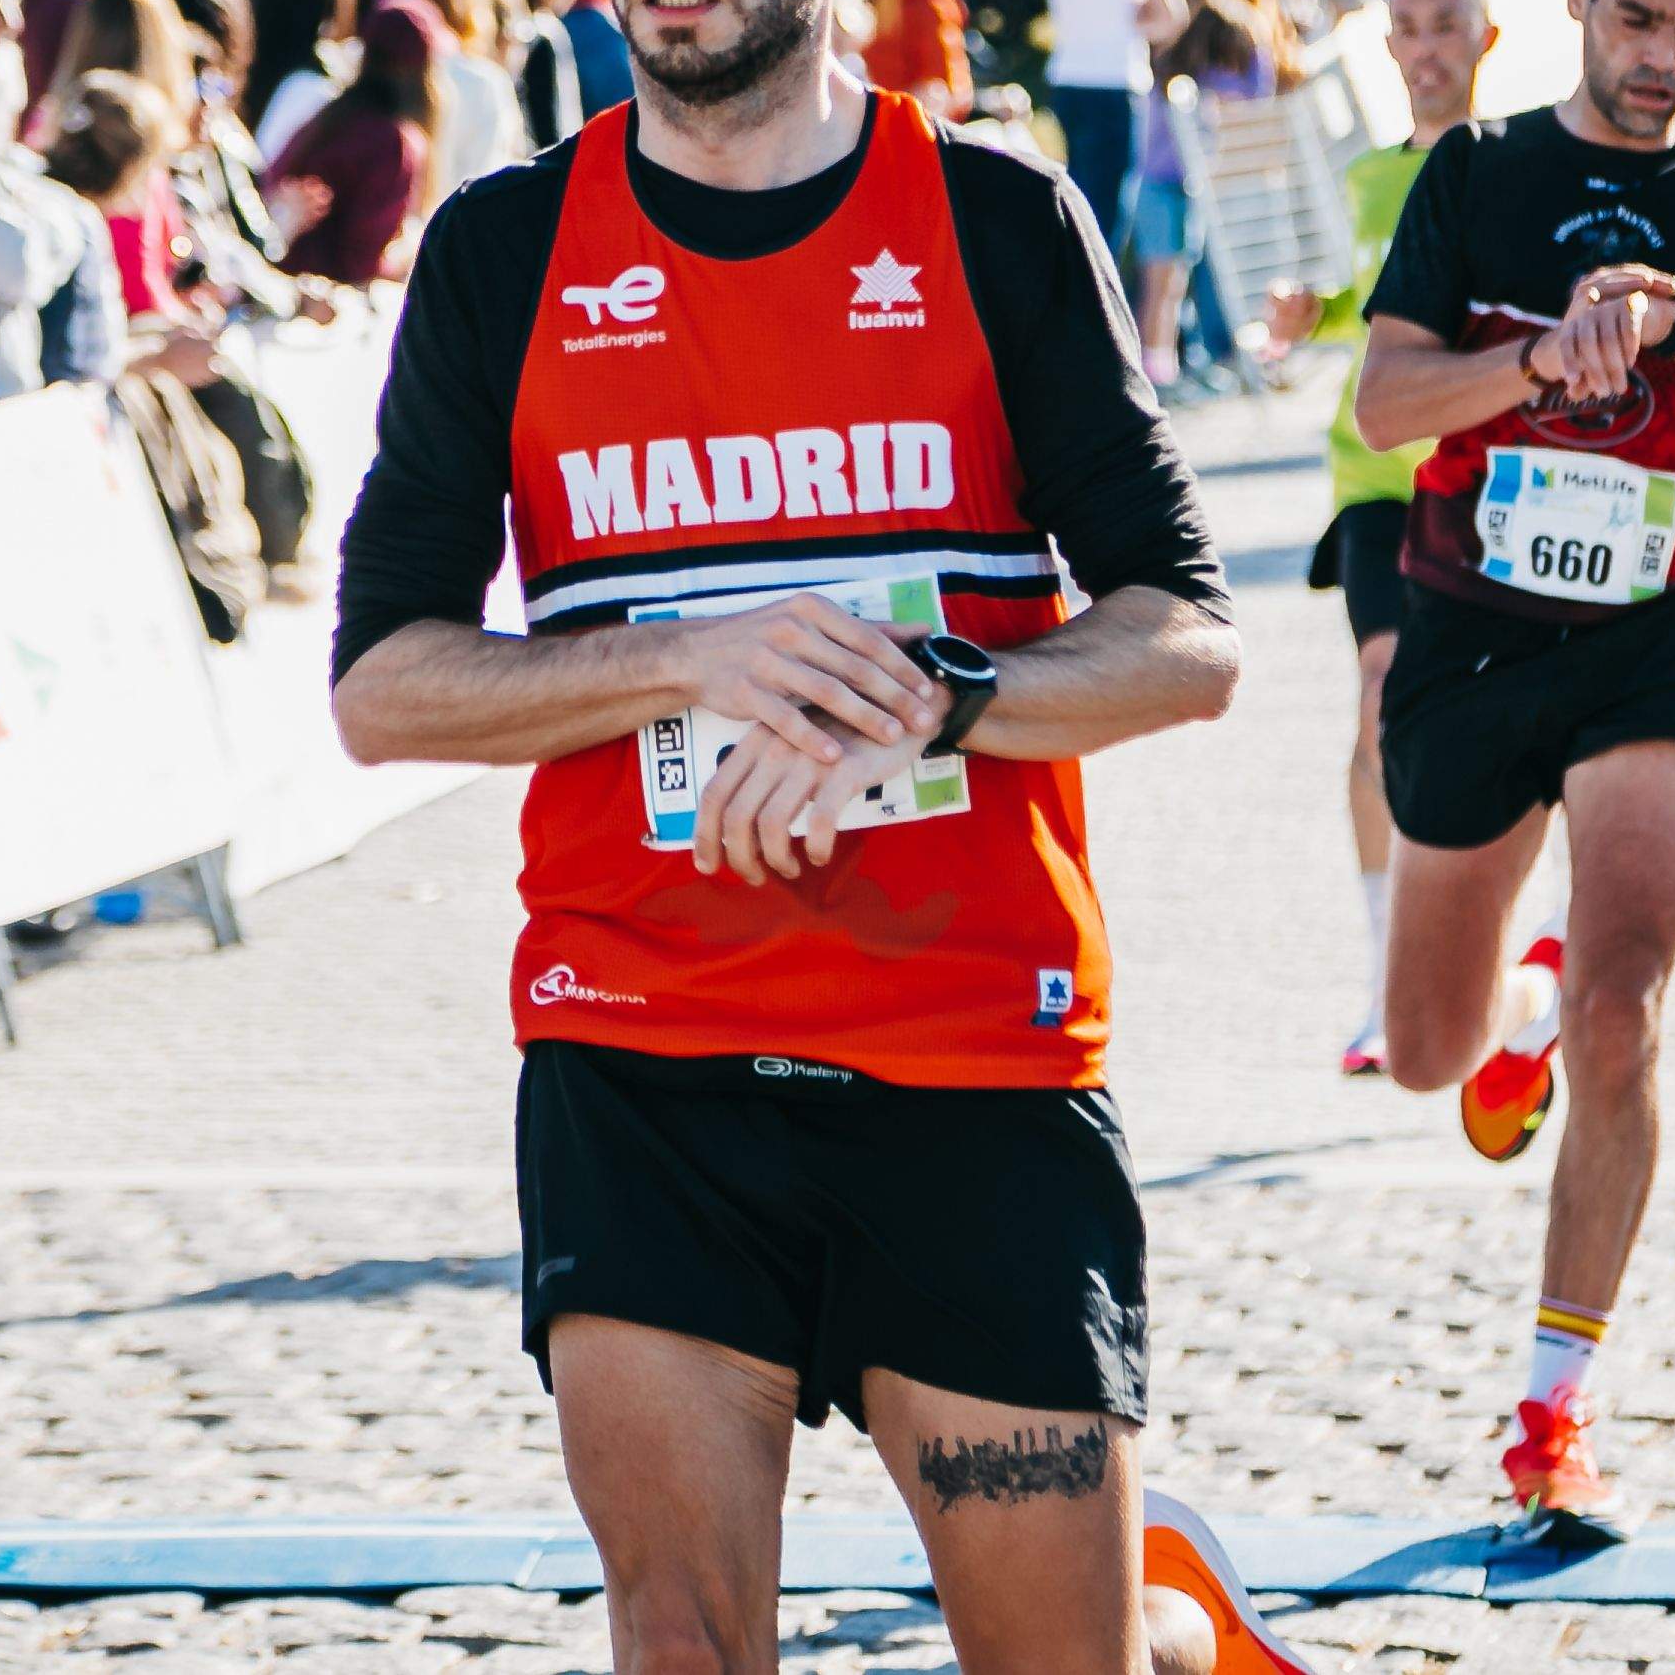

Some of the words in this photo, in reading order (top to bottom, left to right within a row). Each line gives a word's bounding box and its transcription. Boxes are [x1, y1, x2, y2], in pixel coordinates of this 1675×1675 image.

[849, 308, 926, 330] luanvi
[561, 329, 667, 354] TotalEnergies
[557, 421, 955, 541] MADRID
[1563, 472, 1637, 495] MetLife
[1531, 535, 1613, 586] 660
